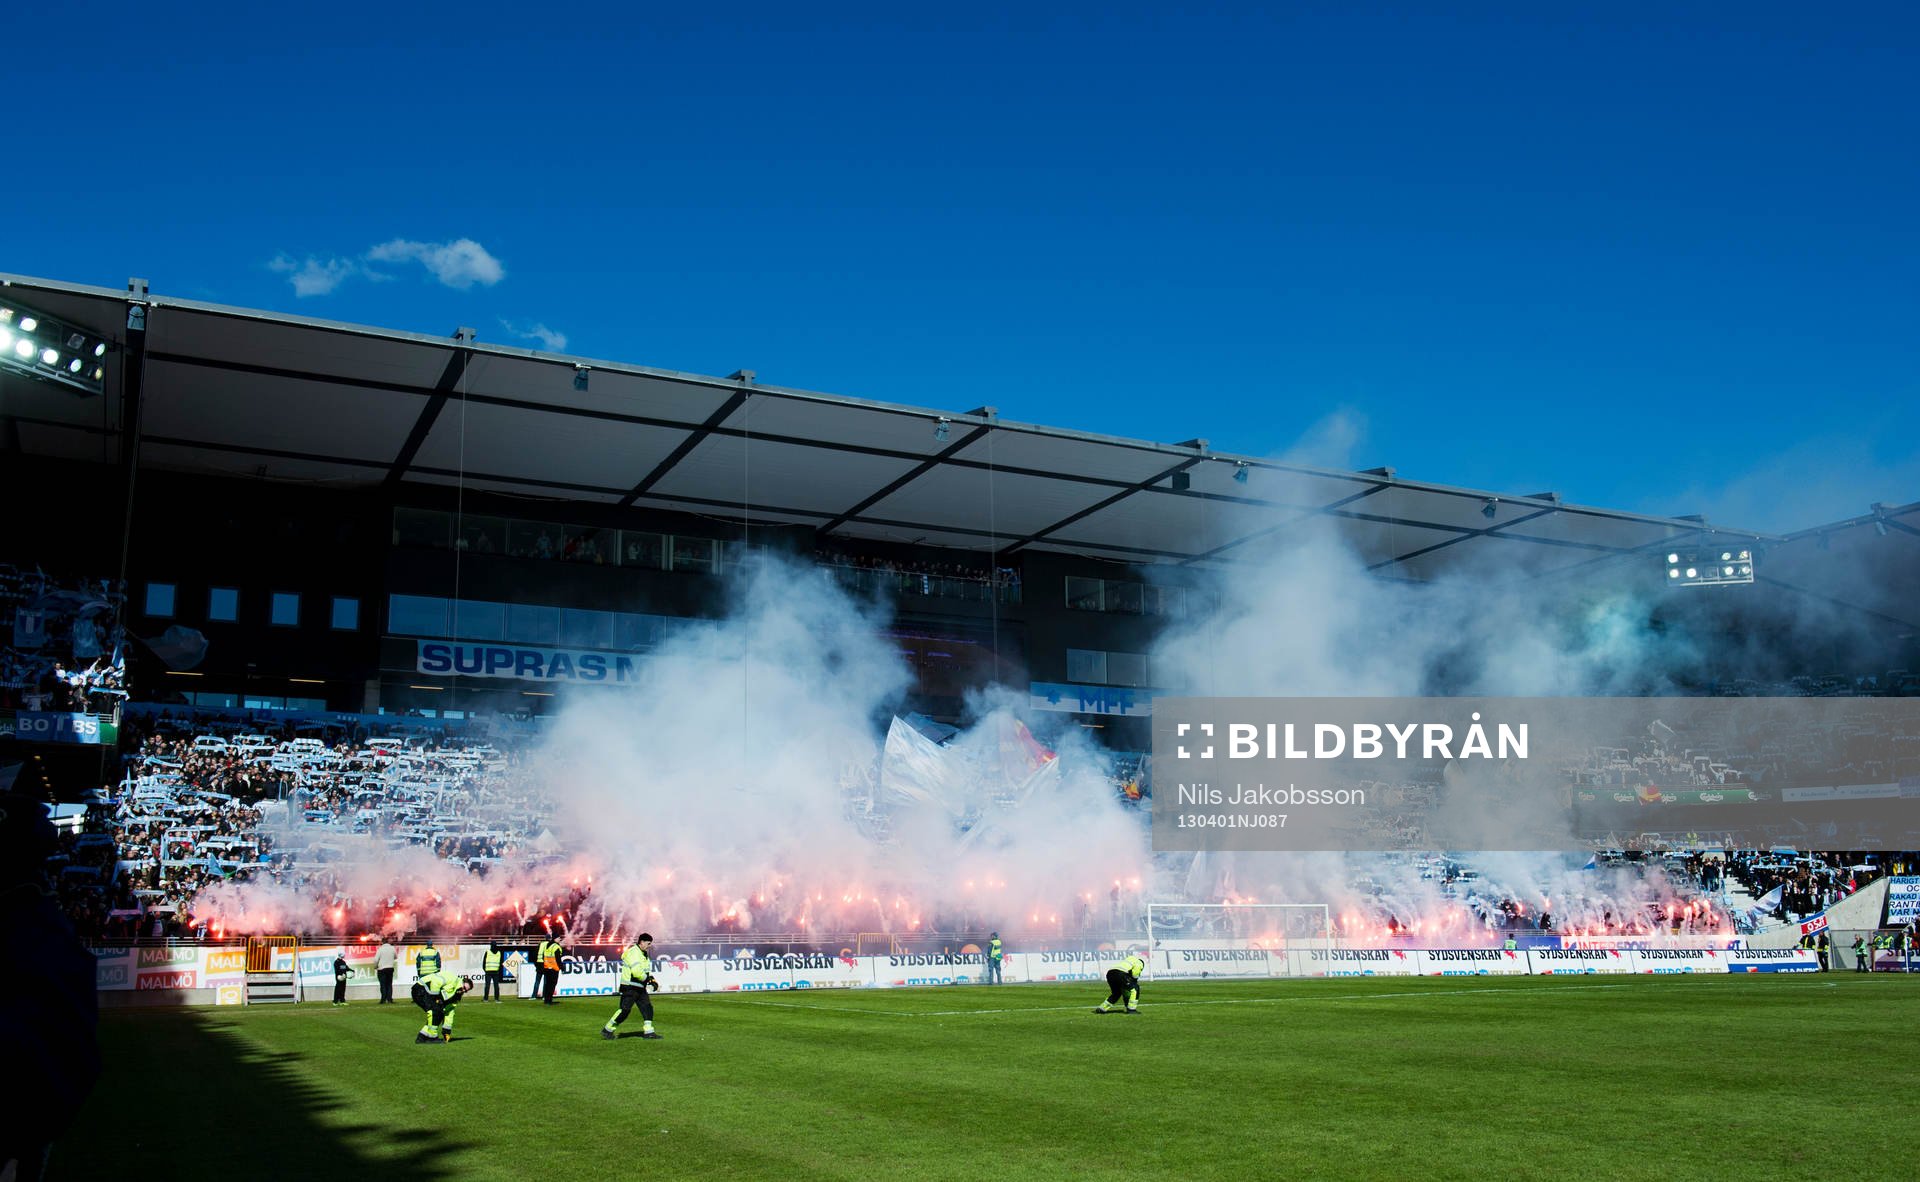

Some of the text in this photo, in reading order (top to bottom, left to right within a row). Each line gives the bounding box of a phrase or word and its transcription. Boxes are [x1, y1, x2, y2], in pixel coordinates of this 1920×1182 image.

[421, 643, 607, 682] SUPRAS
[1079, 688, 1135, 714] MFF
[142, 947, 195, 962] MALMÖ
[1183, 950, 1268, 961] SYDSVENSKAN
[1428, 950, 1502, 960] SYDSVENSKAN
[1539, 950, 1608, 959] SYDSVENSKAN
[1641, 950, 1704, 959] SYDSVENSKAN
[1735, 950, 1794, 959] SYDSVENSKAN
[280, 957, 332, 974] MLMÖ
[723, 957, 834, 971] SYDSVENSKAN
[140, 972, 193, 990] MALMÖ
